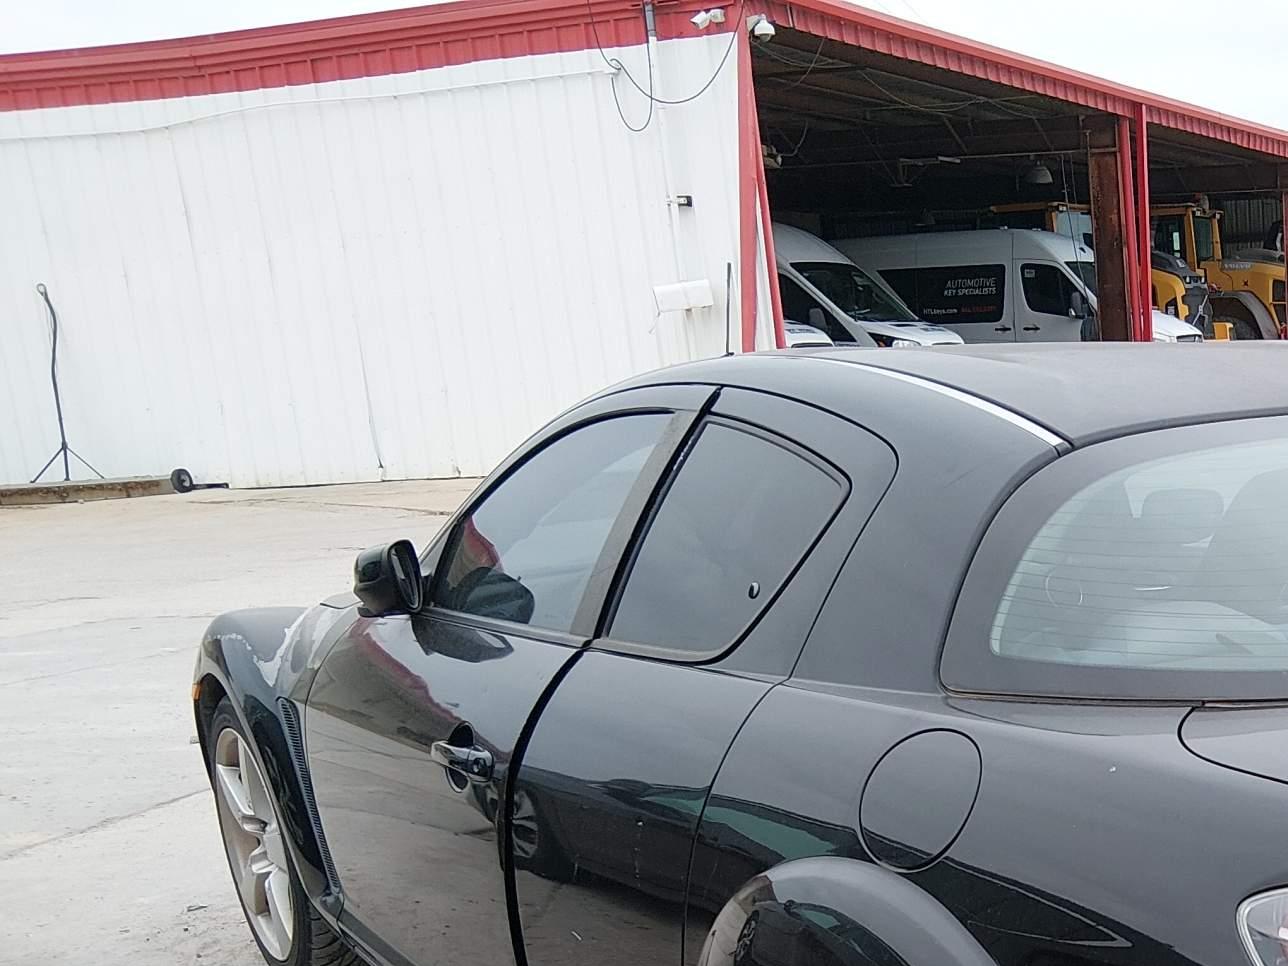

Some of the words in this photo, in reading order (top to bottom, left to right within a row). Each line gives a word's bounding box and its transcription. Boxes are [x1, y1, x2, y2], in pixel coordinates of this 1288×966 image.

[945, 278, 997, 289] AUTOMOTIVE
[943, 288, 956, 297] KEY
[957, 287, 997, 296] SPECIALISTS
